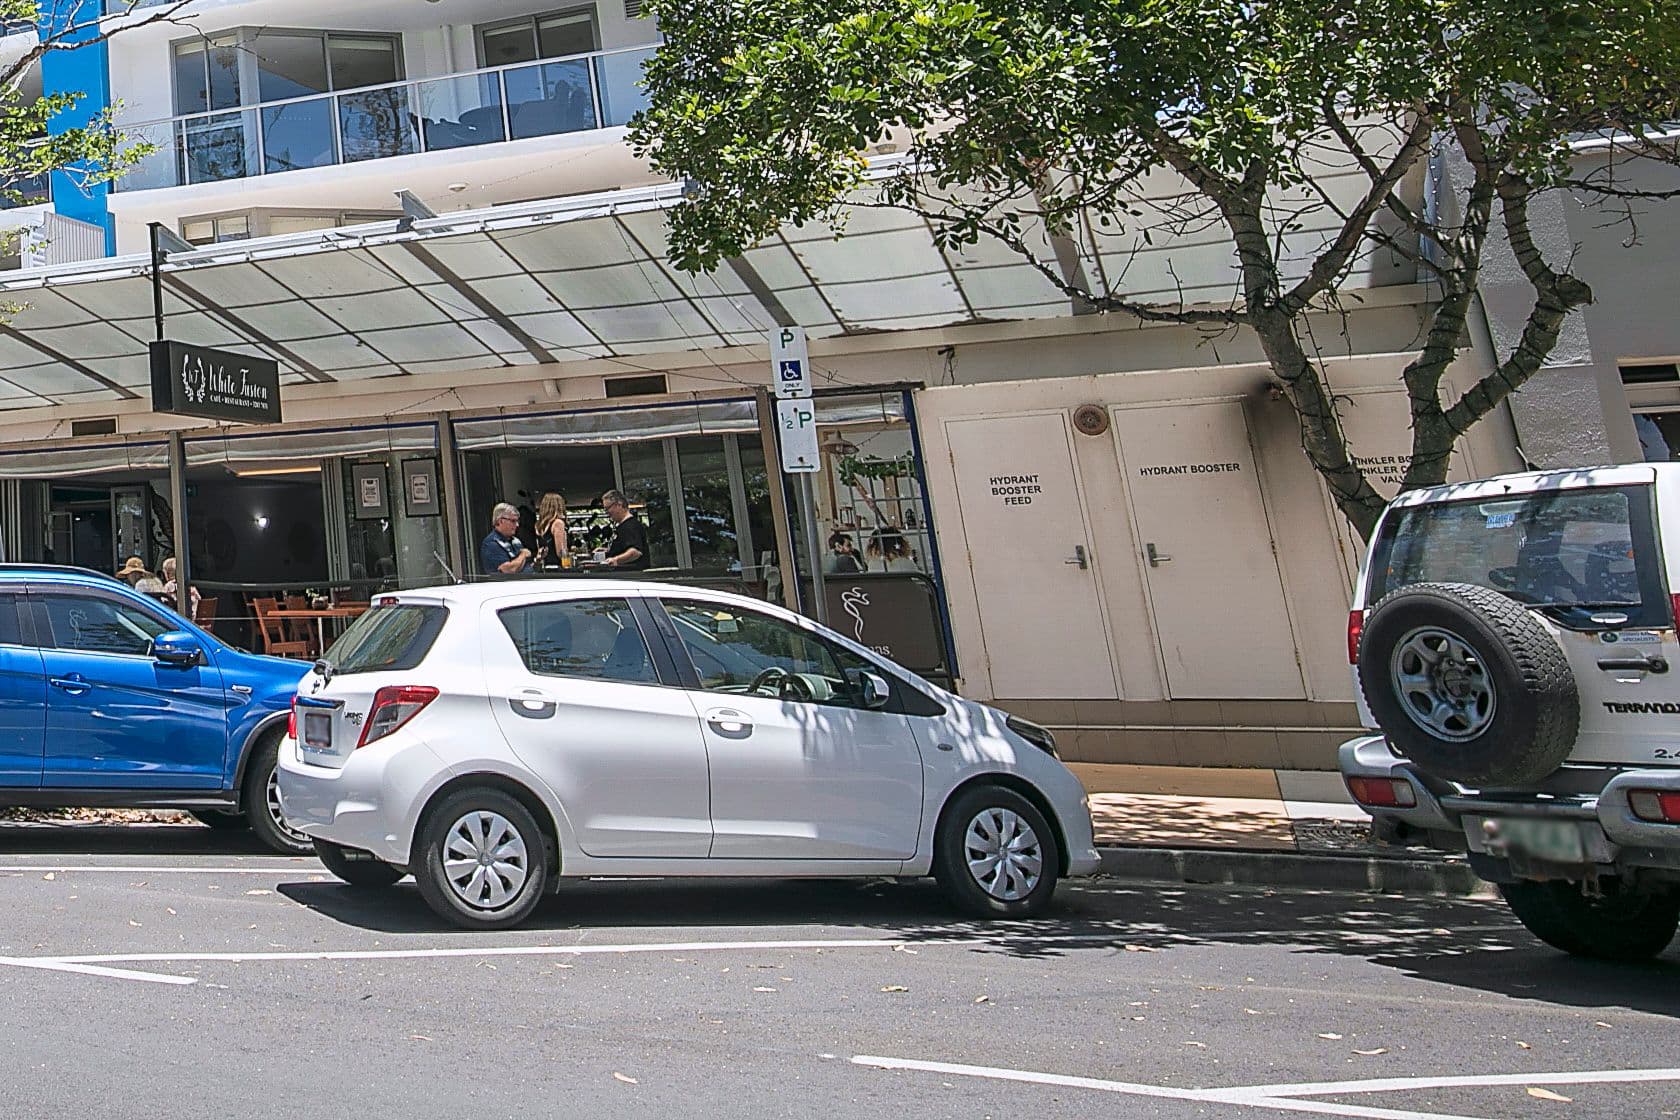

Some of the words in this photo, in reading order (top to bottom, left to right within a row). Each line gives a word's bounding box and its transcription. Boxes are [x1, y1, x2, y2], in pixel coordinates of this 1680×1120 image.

[780, 332, 794, 349] P
[209, 363, 235, 394] White
[240, 368, 267, 400] Fusion
[799, 411, 812, 429] P
[1140, 465, 1188, 476] HYDRANT
[1190, 463, 1241, 475] BOOSTER
[989, 475, 1039, 486] HYDRANT
[991, 485, 1042, 496] BOOSTER
[1004, 496, 1032, 506] FEED
